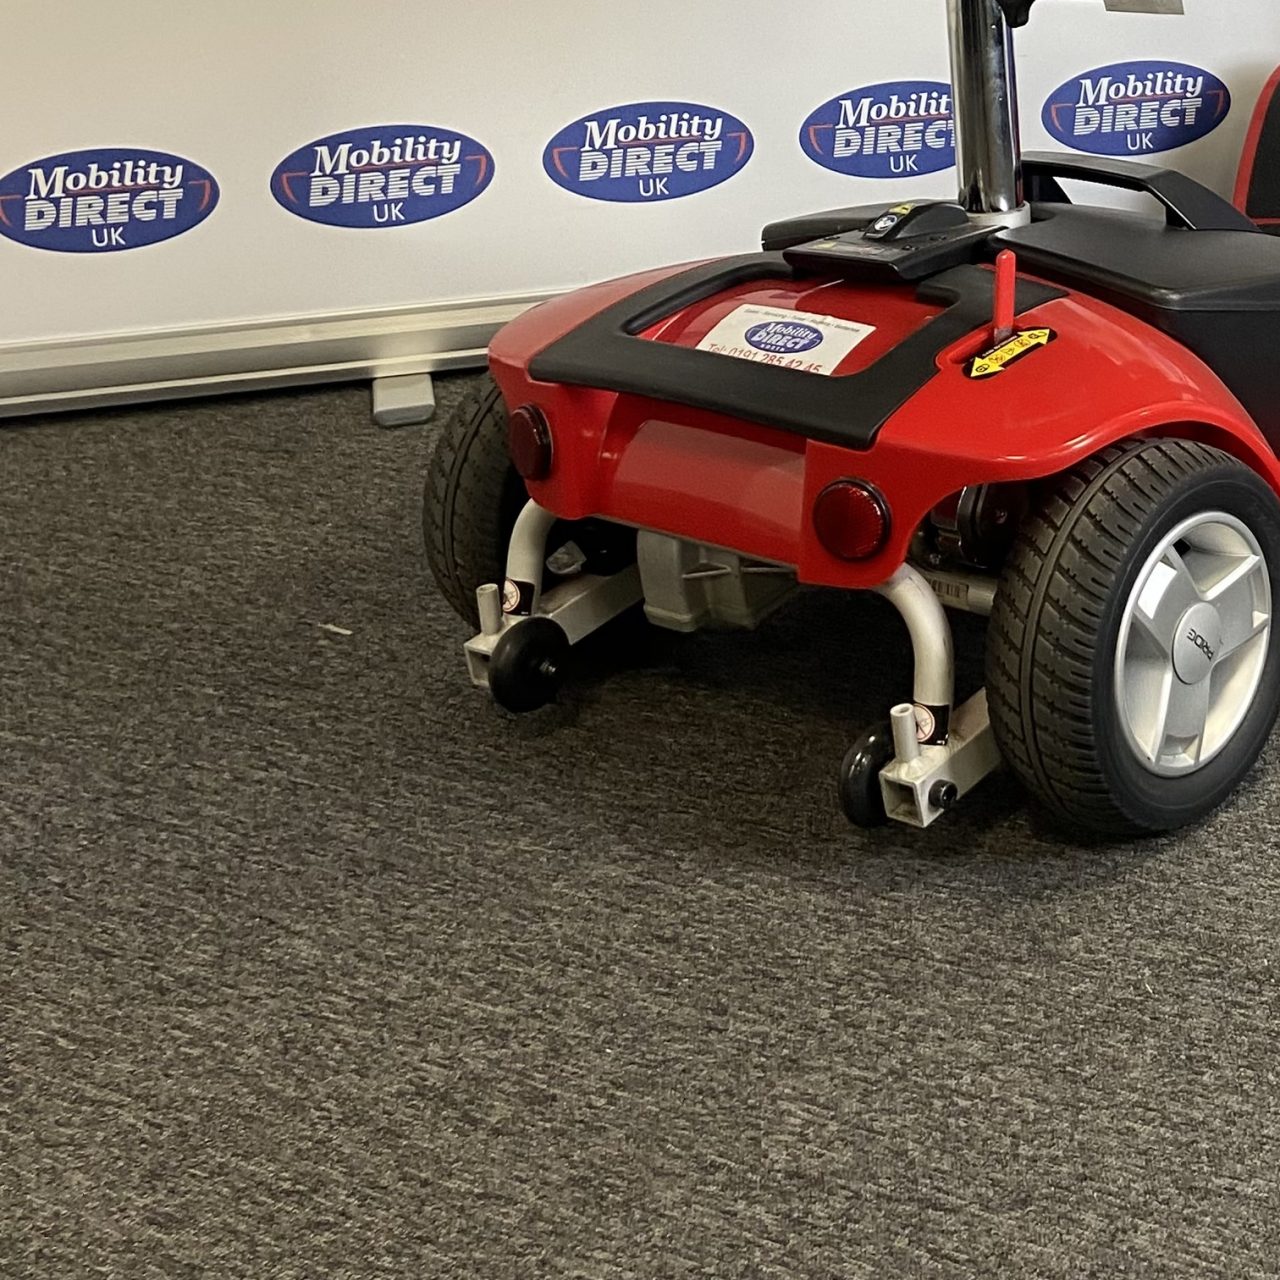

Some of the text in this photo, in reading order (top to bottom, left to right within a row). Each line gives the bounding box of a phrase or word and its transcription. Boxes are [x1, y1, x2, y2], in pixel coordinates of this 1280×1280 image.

[1075, 71, 1203, 107] Mobility
[835, 91, 953, 129] Mobilit
[1073, 98, 1202, 136] DIRECT
[580, 112, 723, 152] Mobility
[1126, 132, 1154, 150] UK
[311, 135, 461, 177] Mobility
[579, 140, 722, 182] DIRECT
[889, 154, 919, 173] UK
[29, 158, 184, 200] Mobility
[308, 163, 462, 207] DIRECT
[639, 177, 669, 196] UK
[24, 188, 184, 231] DIRECT
[373, 201, 405, 224] UK
[91, 226, 126, 248] UK
[751, 327, 810, 349] DIRECT
[767, 323, 818, 340] Mobility
